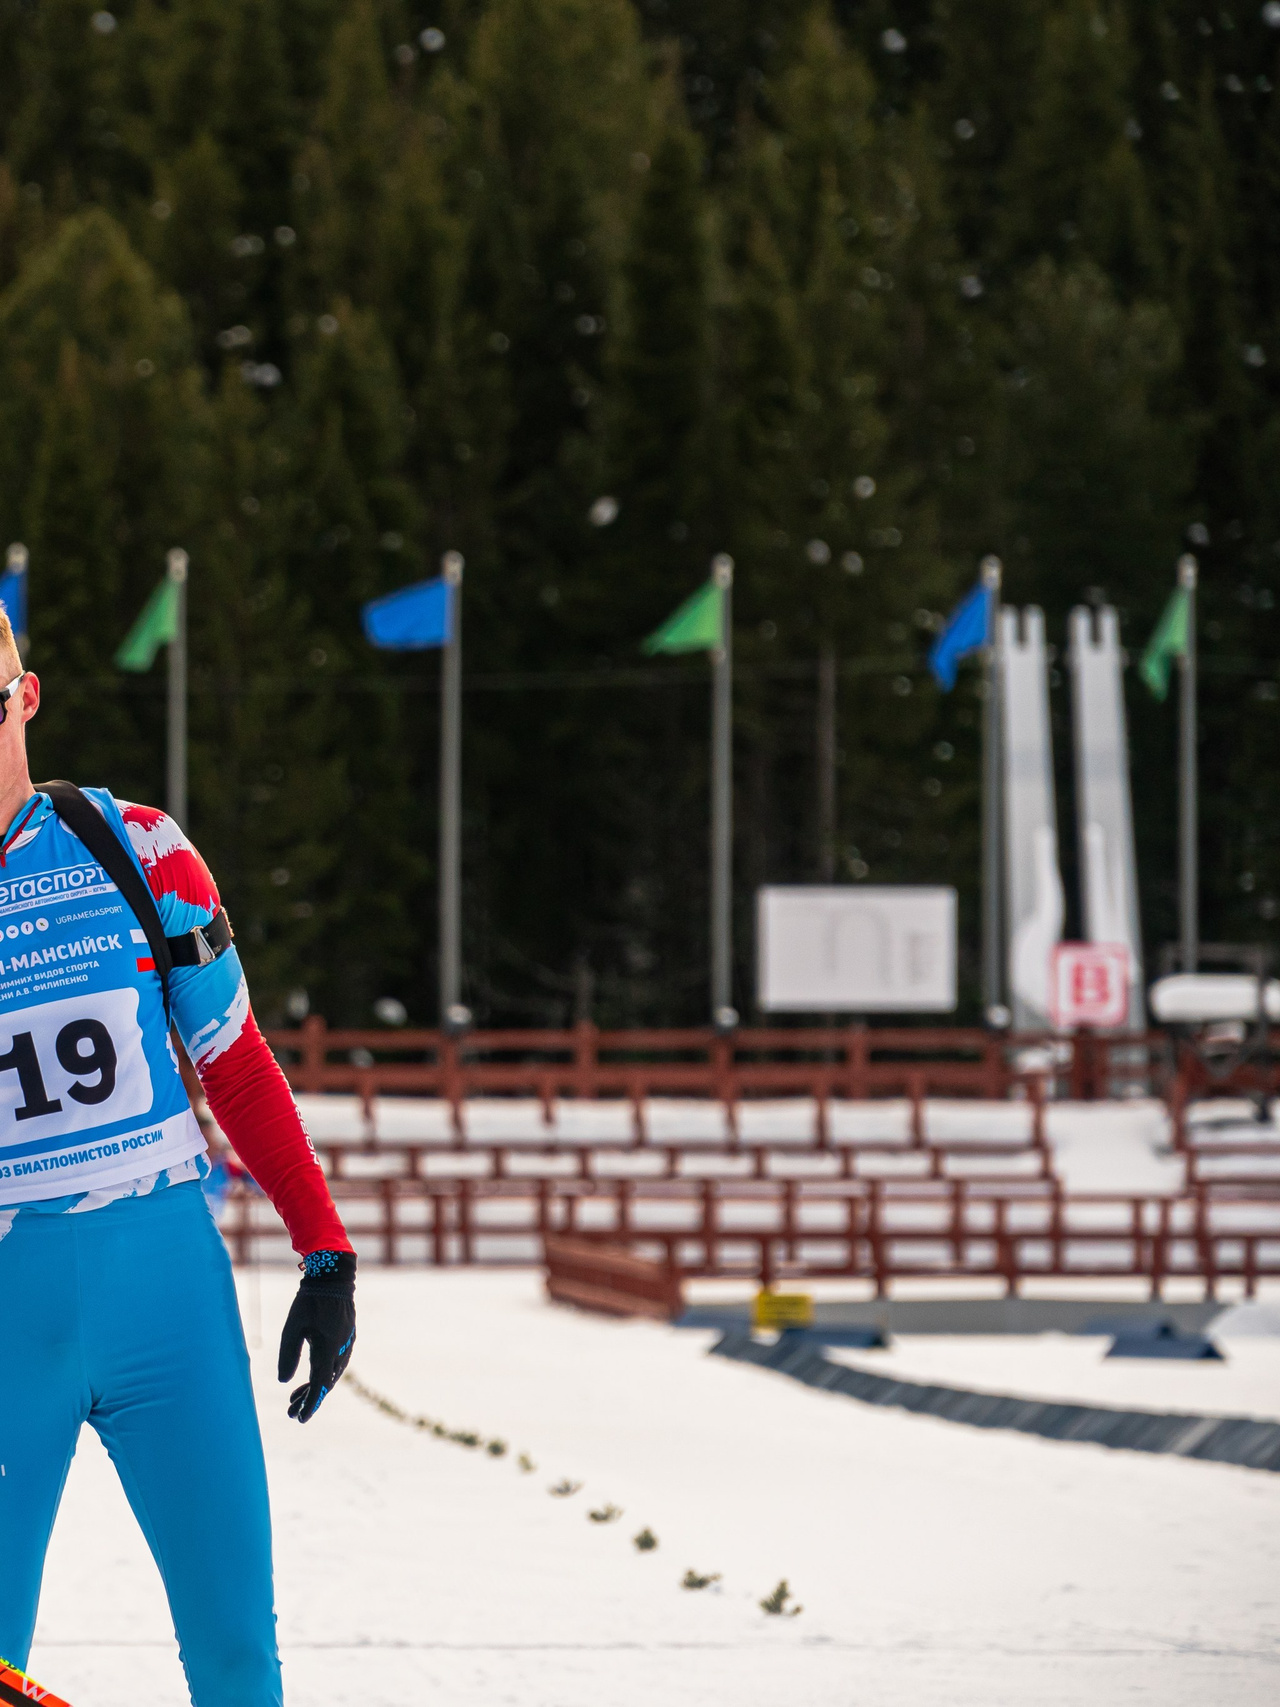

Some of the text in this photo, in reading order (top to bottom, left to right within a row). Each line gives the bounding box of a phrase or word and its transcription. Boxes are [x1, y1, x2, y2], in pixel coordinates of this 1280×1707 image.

[55, 905, 123, 925] UGRAMEGASPORT
[34, 968, 65, 981] ВИДОВ
[65, 960, 100, 973] СПОРТА
[15, 987, 33, 998] А.В.
[33, 974, 89, 992] ФИЛИПЕНКО
[13, 1143, 121, 1178] БИАТЛОНИСТОВ
[121, 1129, 164, 1153] РОССИИ
